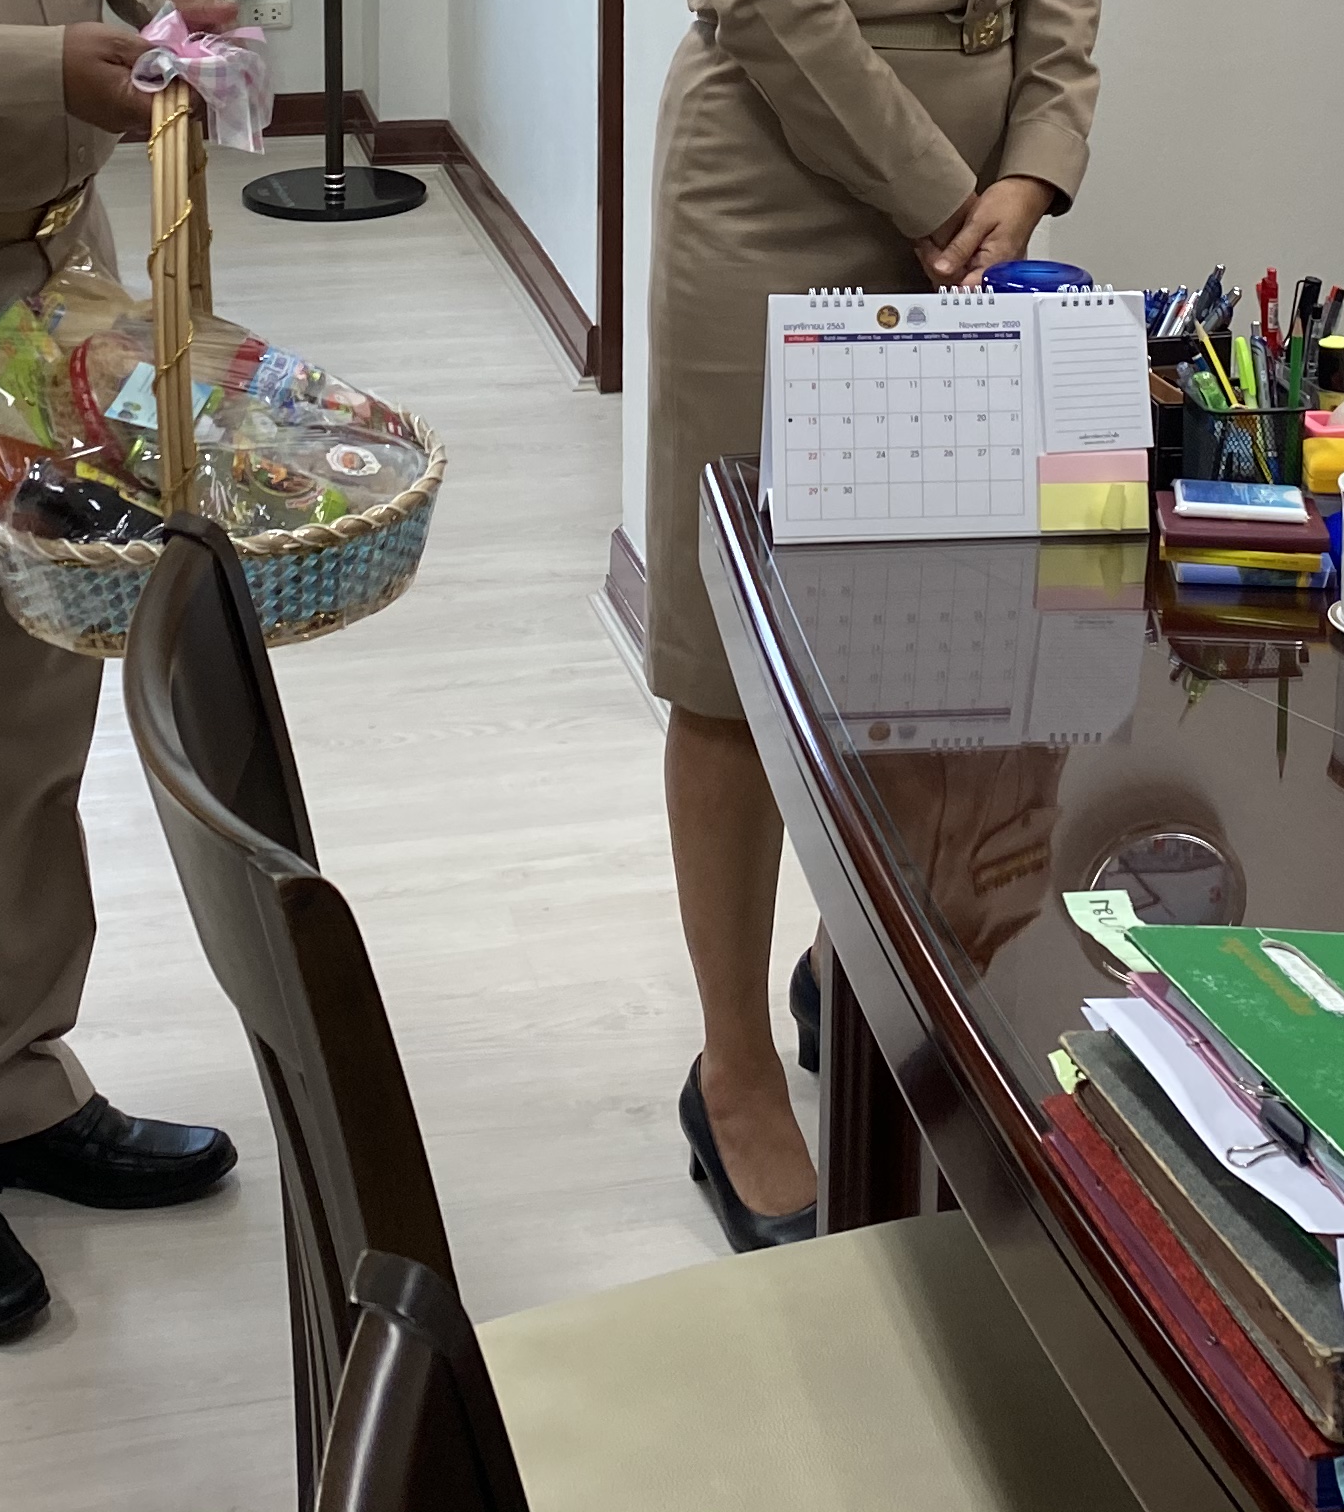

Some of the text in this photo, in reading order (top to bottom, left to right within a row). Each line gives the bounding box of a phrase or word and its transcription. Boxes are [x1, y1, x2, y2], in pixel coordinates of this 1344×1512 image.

[827, 322, 845, 330] 2563
[959, 320, 1020, 329] November 2020
[876, 381, 884, 389] 10
[943, 380, 951, 388] 12
[977, 379, 985, 387] 13
[808, 417, 817, 425] 15
[910, 415, 919, 423] 18
[977, 414, 986, 422] 20
[808, 452, 817, 460] 22
[910, 450, 919, 458] 25
[809, 487, 818, 495] 29
